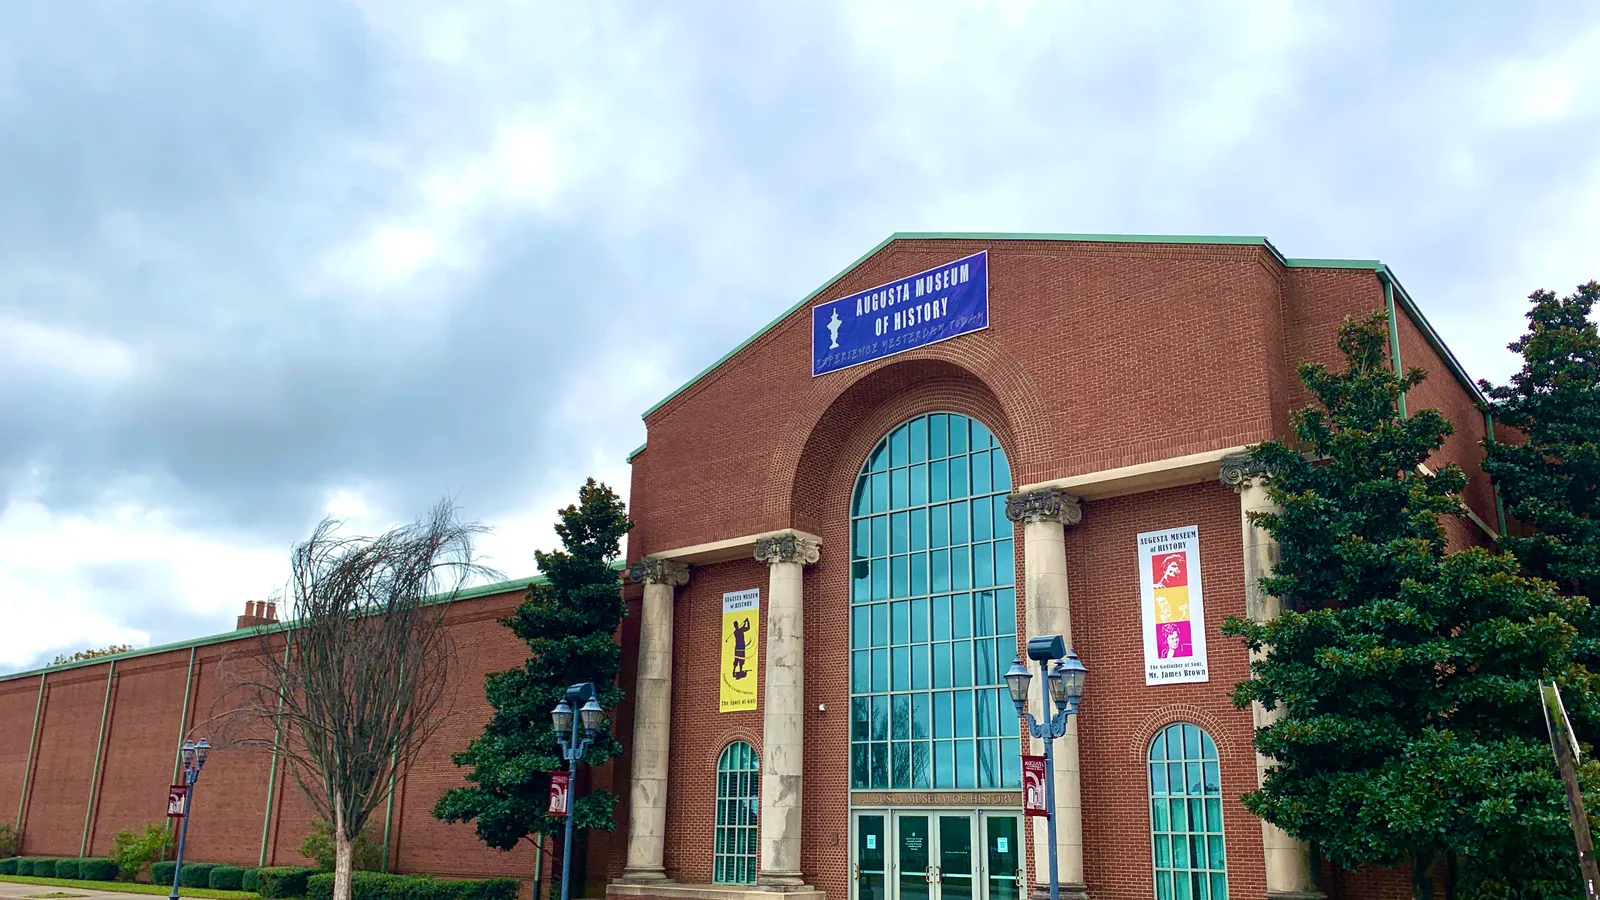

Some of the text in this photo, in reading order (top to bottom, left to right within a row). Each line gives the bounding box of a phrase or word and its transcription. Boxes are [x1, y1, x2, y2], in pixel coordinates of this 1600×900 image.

[856, 263, 969, 316] AUGUSTA MUSEUM
[875, 297, 948, 337] OF HISTORY
[816, 312, 984, 370] EXPERIENCE YESTERDAY TODAY
[1140, 531, 1197, 545] AUGUSTA MUSEUM
[1157, 541, 1187, 552] HISTORY
[1161, 671, 1181, 679] James
[1184, 669, 1206, 677] Brown
[861, 795, 1015, 804] AUGUSTA MUSEUM OF HISTORY
